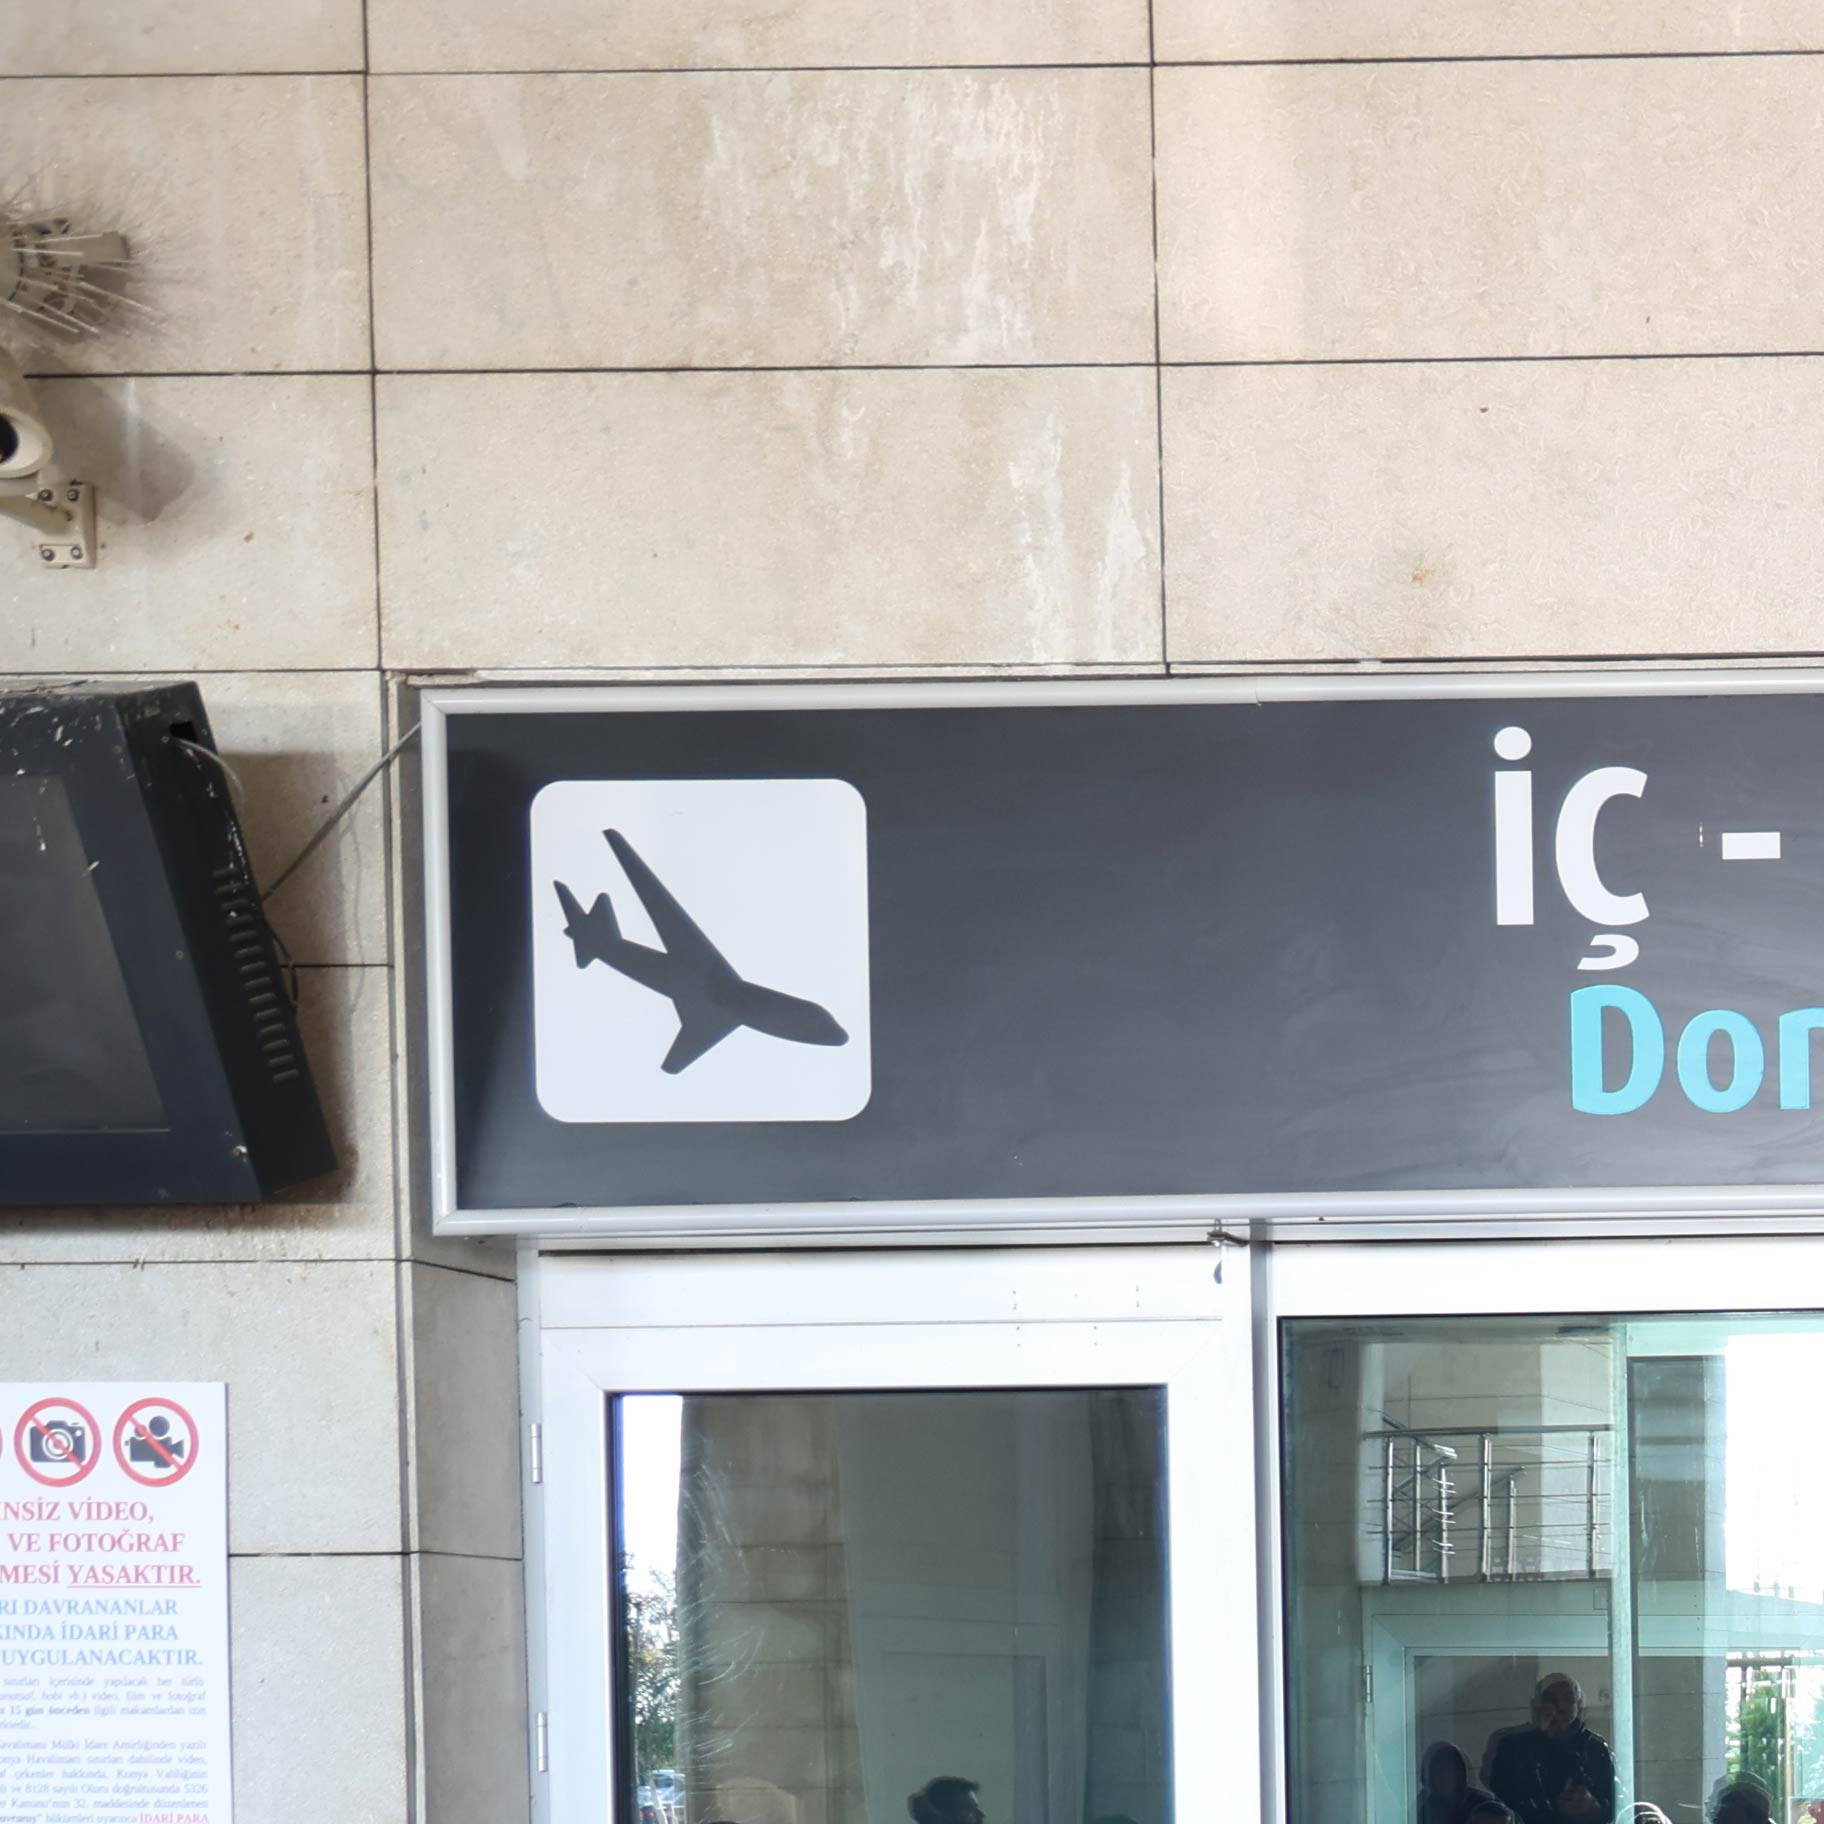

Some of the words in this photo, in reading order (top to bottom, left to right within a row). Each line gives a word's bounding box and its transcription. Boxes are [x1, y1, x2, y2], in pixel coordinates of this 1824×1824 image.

[1494, 725, 1649, 972] İÇ
[1722, 832, 1780, 860] -
[0, 1496, 60, 1521] NSİZ
[67, 1496, 154, 1523] VİDEO,
[7, 1533, 41, 1552] VE
[48, 1528, 186, 1552] FOTOĞRAF
[67, 1565, 202, 1586] YASAKTIR.
[23, 1600, 178, 1615] DAVRANANLAR
[61, 1621, 118, 1641] İDARİ
[124, 1625, 179, 1640] PARA
[2, 1649, 203, 1666] UYGULANACAKTIR.
[140, 1811, 174, 1824] İDARİ
[177, 1813, 209, 1824] PARA
